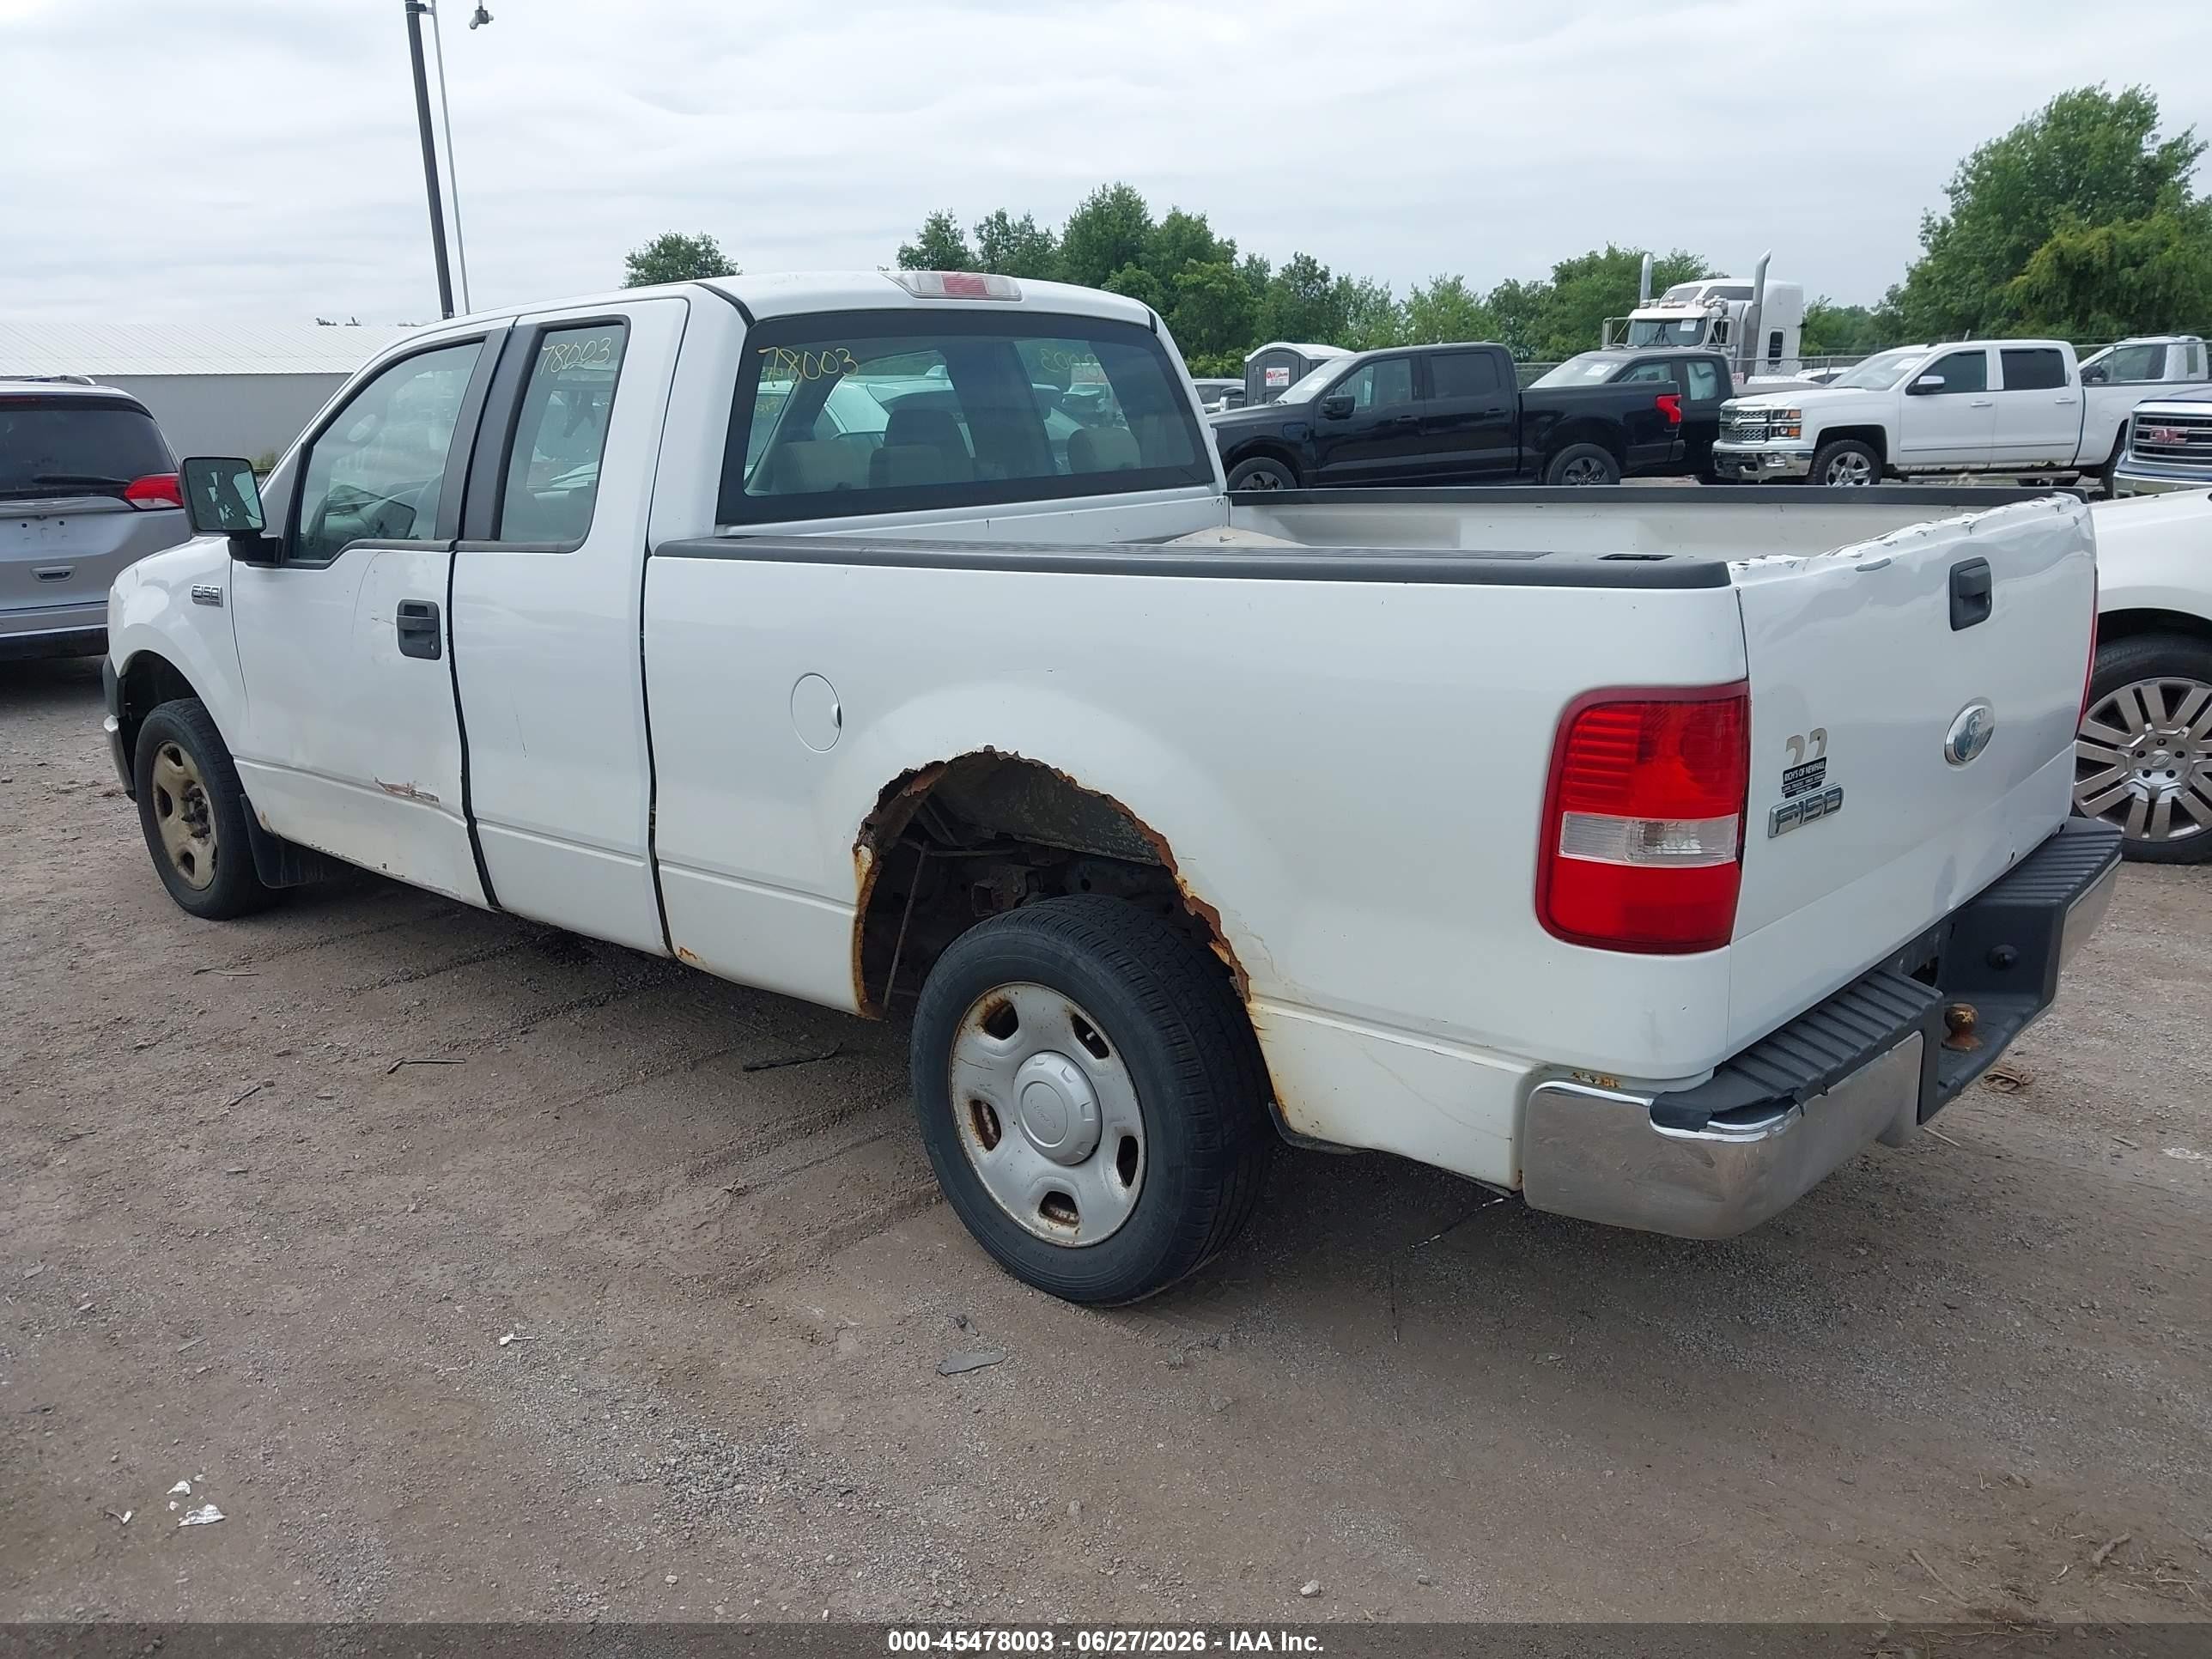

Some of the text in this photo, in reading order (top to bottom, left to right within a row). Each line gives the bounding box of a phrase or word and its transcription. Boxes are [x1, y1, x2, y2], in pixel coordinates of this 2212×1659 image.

[540, 337, 611, 376] 78003
[757, 346, 859, 388] 78003
[2149, 428, 2187, 445] GMC
